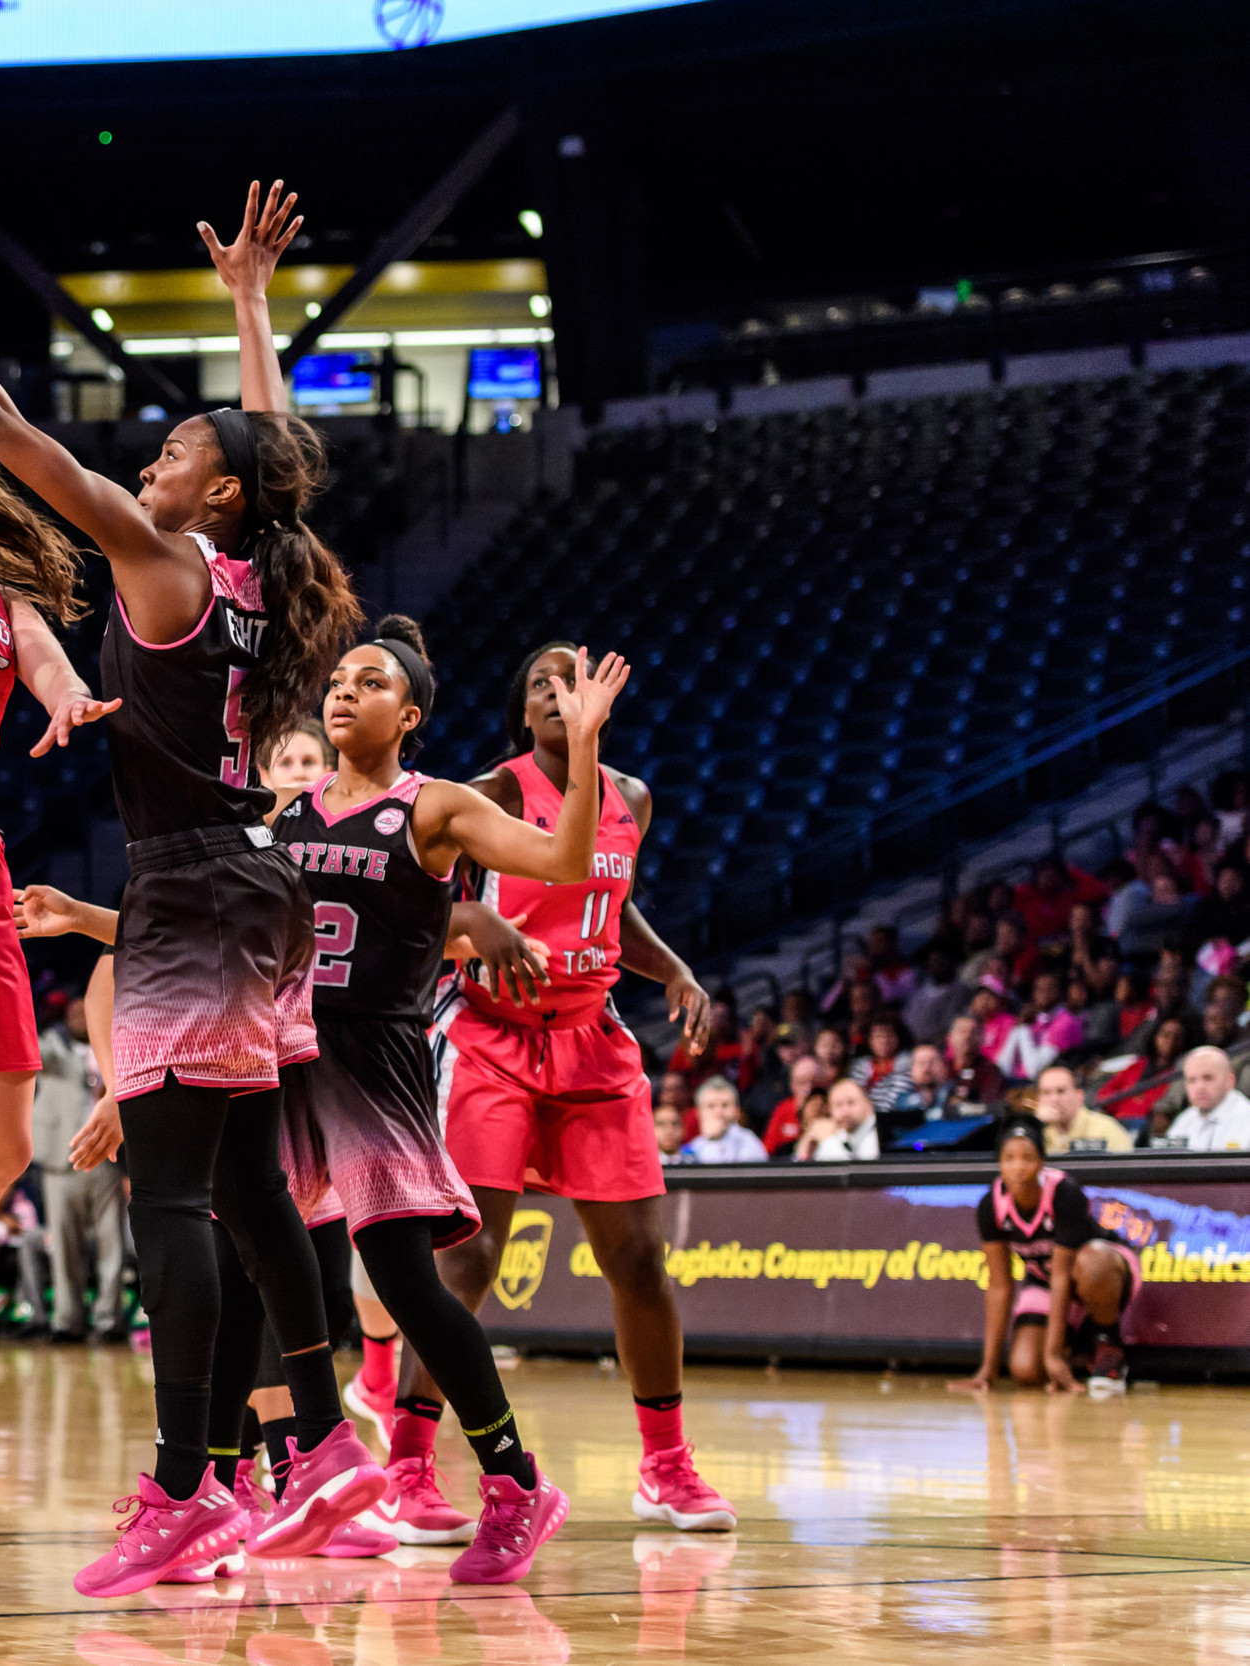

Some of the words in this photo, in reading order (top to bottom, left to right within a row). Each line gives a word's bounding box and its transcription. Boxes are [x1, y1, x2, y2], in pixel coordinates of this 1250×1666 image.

[288, 842, 389, 881] STATE
[580, 889, 611, 940] 11
[312, 900, 359, 988] 2
[764, 1242, 888, 1289] Company
[886, 1240, 921, 1280] of
